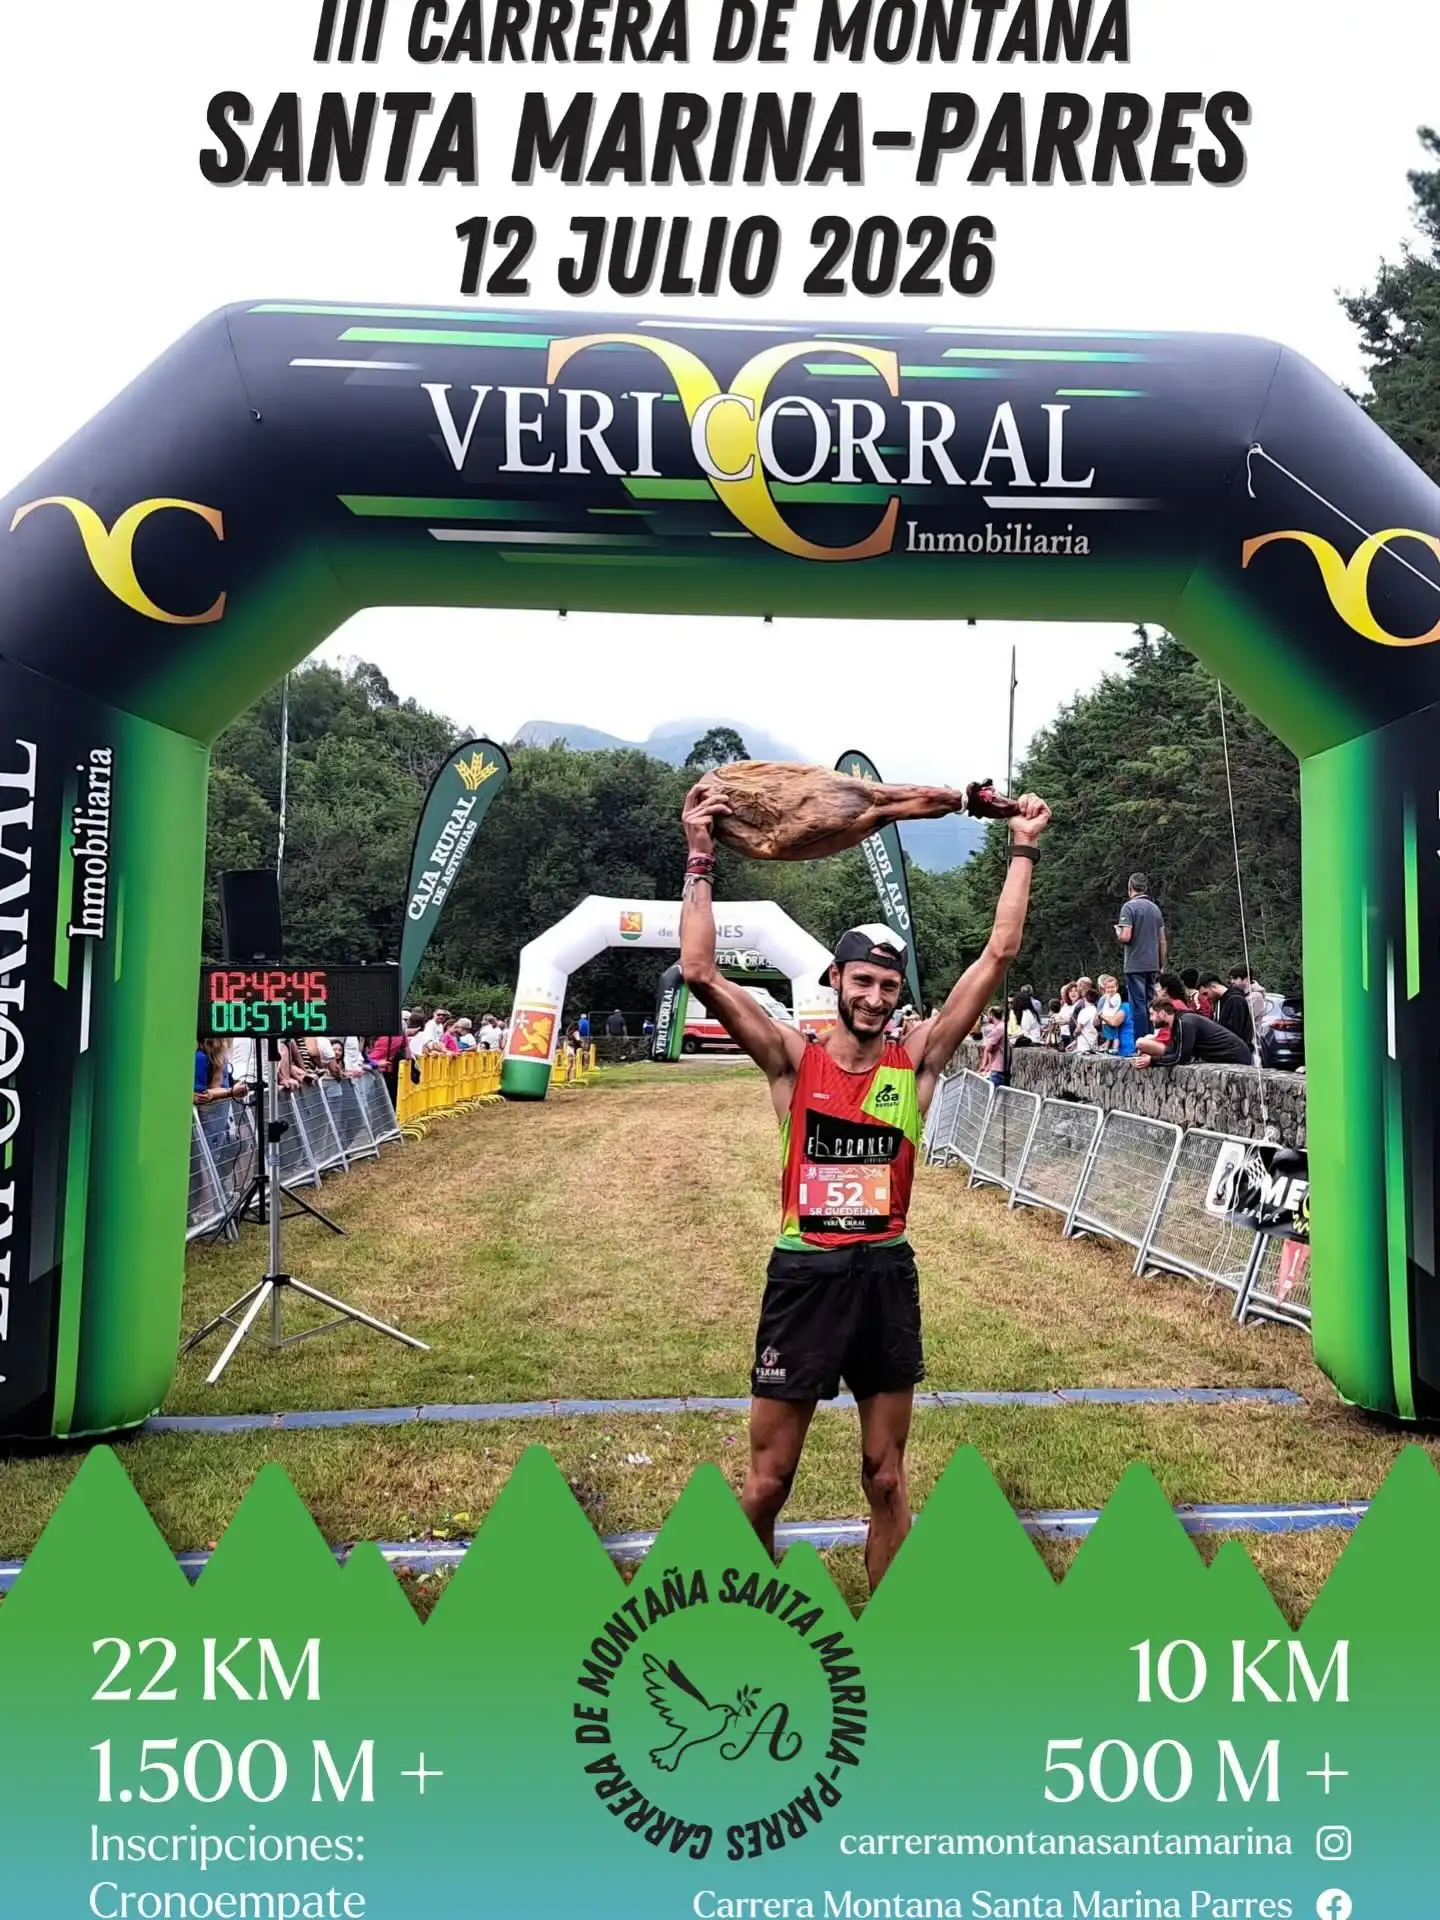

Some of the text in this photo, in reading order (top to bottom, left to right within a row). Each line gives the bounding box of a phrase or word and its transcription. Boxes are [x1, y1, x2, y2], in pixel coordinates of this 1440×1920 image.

[420, 381, 1096, 490] VERI CORRAL
[906, 521, 1091, 555] Inmobiliaria
[68, 746, 113, 938] Inmobiliaria
[408, 795, 477, 920] CAJA RURAL
[431, 819, 478, 906] DE ASTURIAS
[211, 971, 328, 1001] 02:42:45
[211, 1001, 328, 1032] 00:57:45
[655, 987, 675, 1054] VERI CORRAL
[825, 1181, 865, 1207] 52
